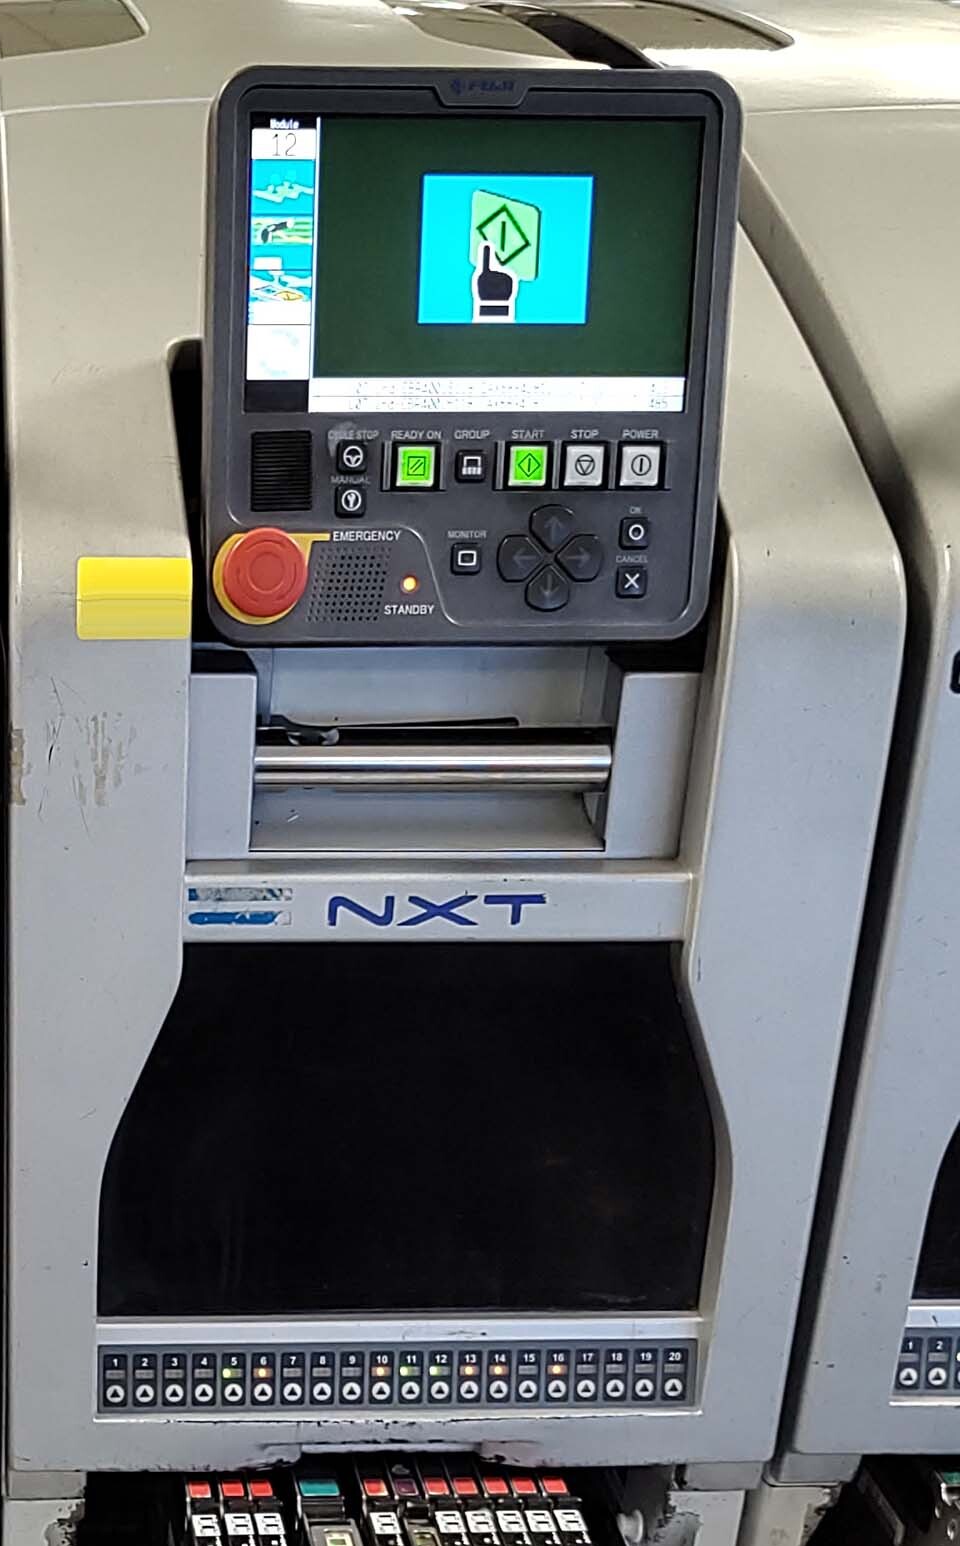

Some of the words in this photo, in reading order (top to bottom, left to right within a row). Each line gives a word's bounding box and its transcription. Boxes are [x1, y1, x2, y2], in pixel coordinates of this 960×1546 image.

[270, 117, 299, 129] Module
[272, 132, 296, 157] 12
[391, 431, 423, 440] READY
[426, 431, 442, 440] ON
[455, 429, 490, 440] GROUP
[512, 430, 544, 439] START
[570, 430, 599, 440] STOP
[623, 430, 659, 439] POWER
[332, 530, 401, 541] EMERGENCY
[448, 530, 487, 539] MONITOR
[616, 554, 648, 564] CANCEL
[384, 605, 435, 616] STANDBY
[327, 894, 547, 927] NXT
[908, 1341, 913, 1350] 1
[936, 1340, 943, 1350] 2
[142, 1358, 148, 1366] 2
[172, 1358, 177, 1366] 3
[232, 1357, 237, 1365] 5
[260, 1357, 266, 1365] 6
[290, 1356, 296, 1365] 7
[320, 1356, 326, 1364] 8
[349, 1356, 355, 1364] 9
[377, 1355, 388, 1364] 10
[407, 1355, 416, 1363] 11
[436, 1355, 447, 1363] 12
[466, 1354, 476, 1363] 13
[495, 1354, 505, 1362] 14
[524, 1354, 535, 1362] 15
[583, 1353, 593, 1361] 17
[612, 1353, 622, 1361] 18
[641, 1352, 652, 1360] 19
[669, 1352, 681, 1360] 20
